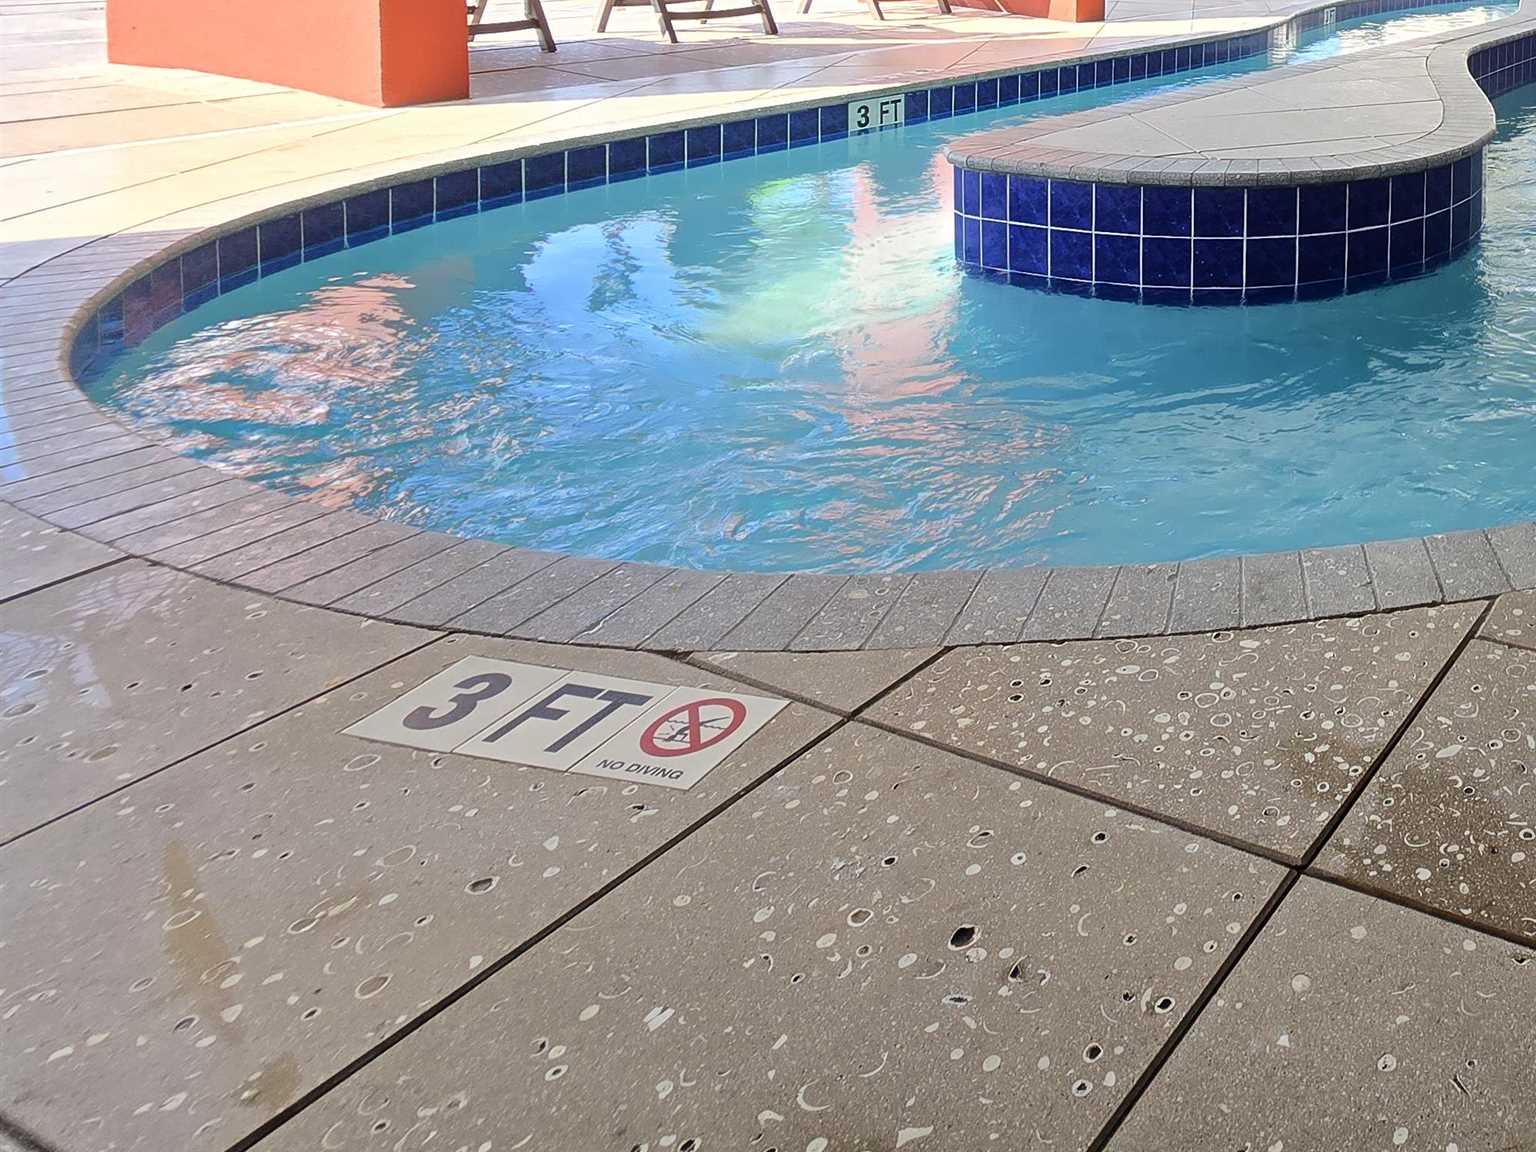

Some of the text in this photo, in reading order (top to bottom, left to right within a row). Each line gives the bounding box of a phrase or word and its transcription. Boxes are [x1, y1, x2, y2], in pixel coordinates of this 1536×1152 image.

[857, 99, 902, 128] 3 FT
[402, 673, 654, 752] 3 FT
[596, 759, 684, 780] NO DIVING
